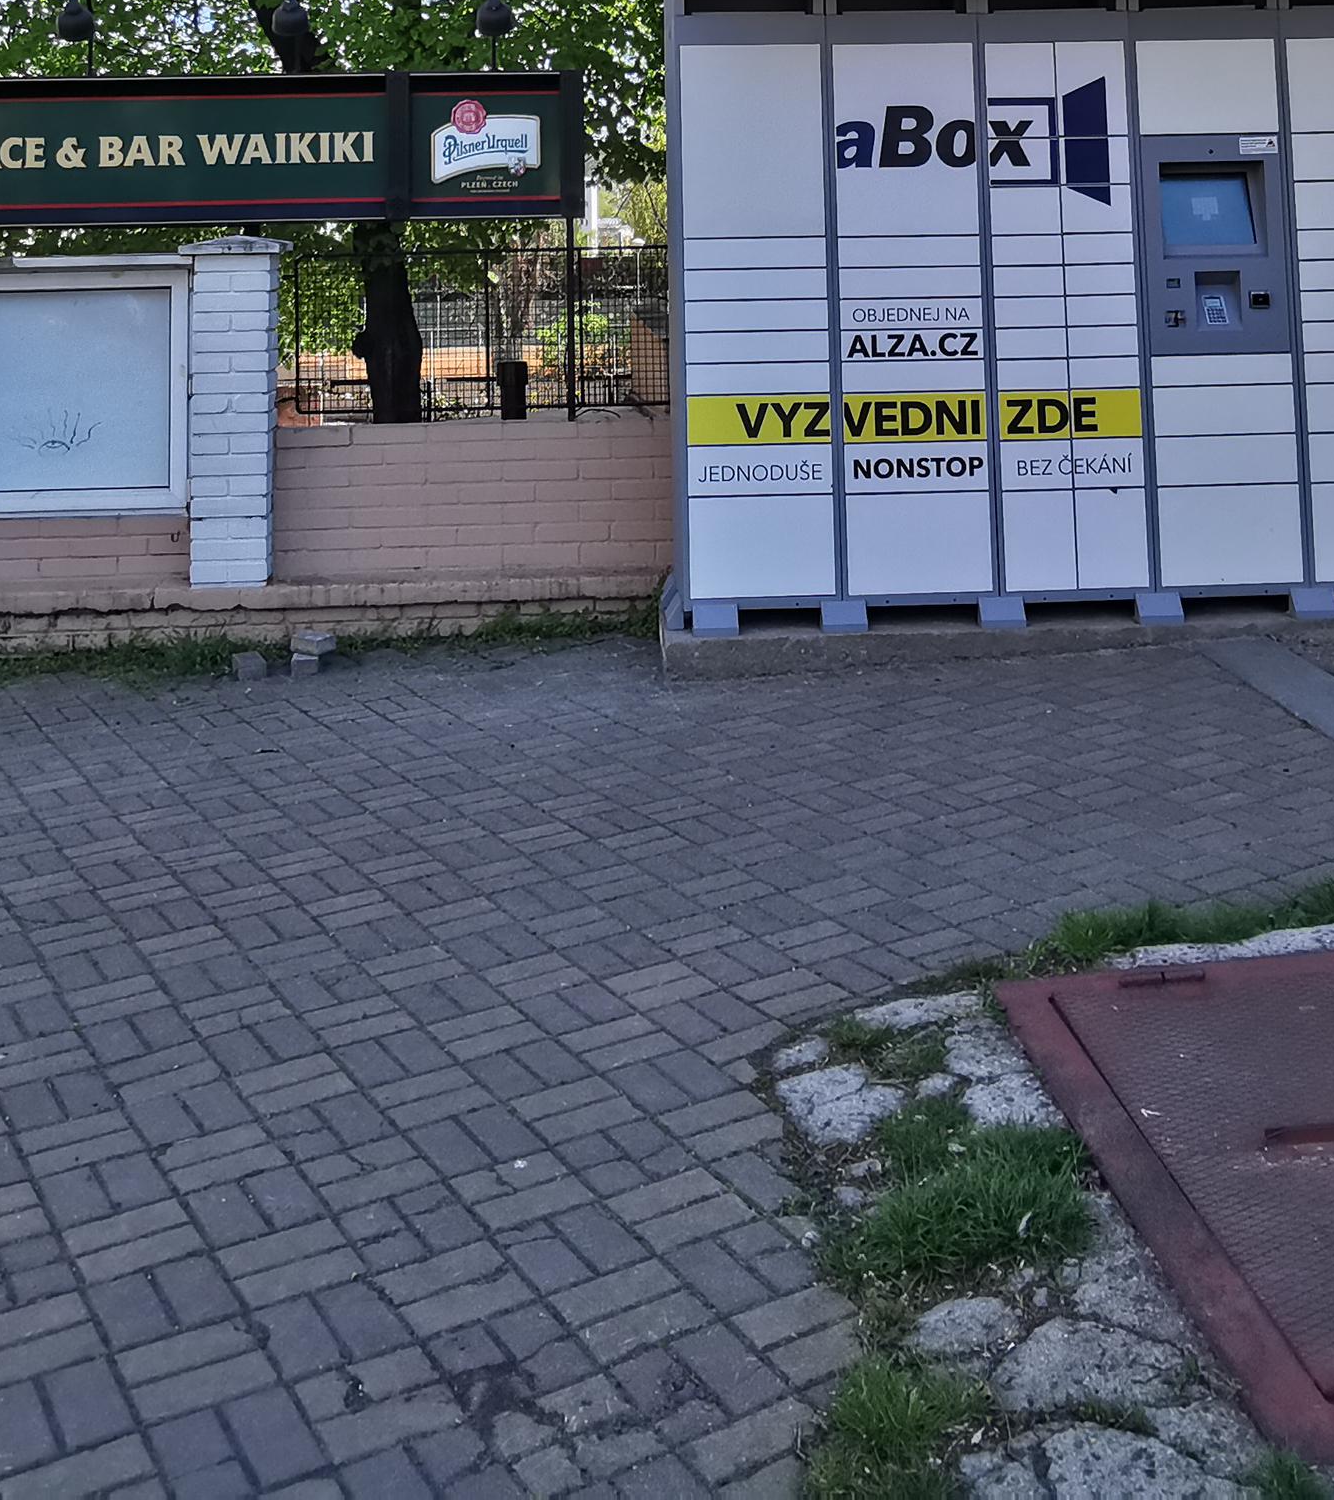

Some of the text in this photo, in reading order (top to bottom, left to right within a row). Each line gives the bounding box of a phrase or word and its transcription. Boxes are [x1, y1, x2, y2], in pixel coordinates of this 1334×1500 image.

[56, 137, 87, 169] &
[98, 134, 187, 168] BAR
[196, 131, 376, 165] WAIKIKI
[443, 133, 528, 166] Pilsner Urquell
[836, 105, 1033, 169] aBox
[492, 180, 518, 188] CZECH
[852, 307, 970, 323] OBJEDNEJ NA
[847, 332, 979, 358] ALZA.CZ
[735, 397, 1099, 438] VYZVEDNI ZDE
[698, 452, 1132, 483] JEDNODUŠE NONSTOP BEZ ČEKÁNÍ
